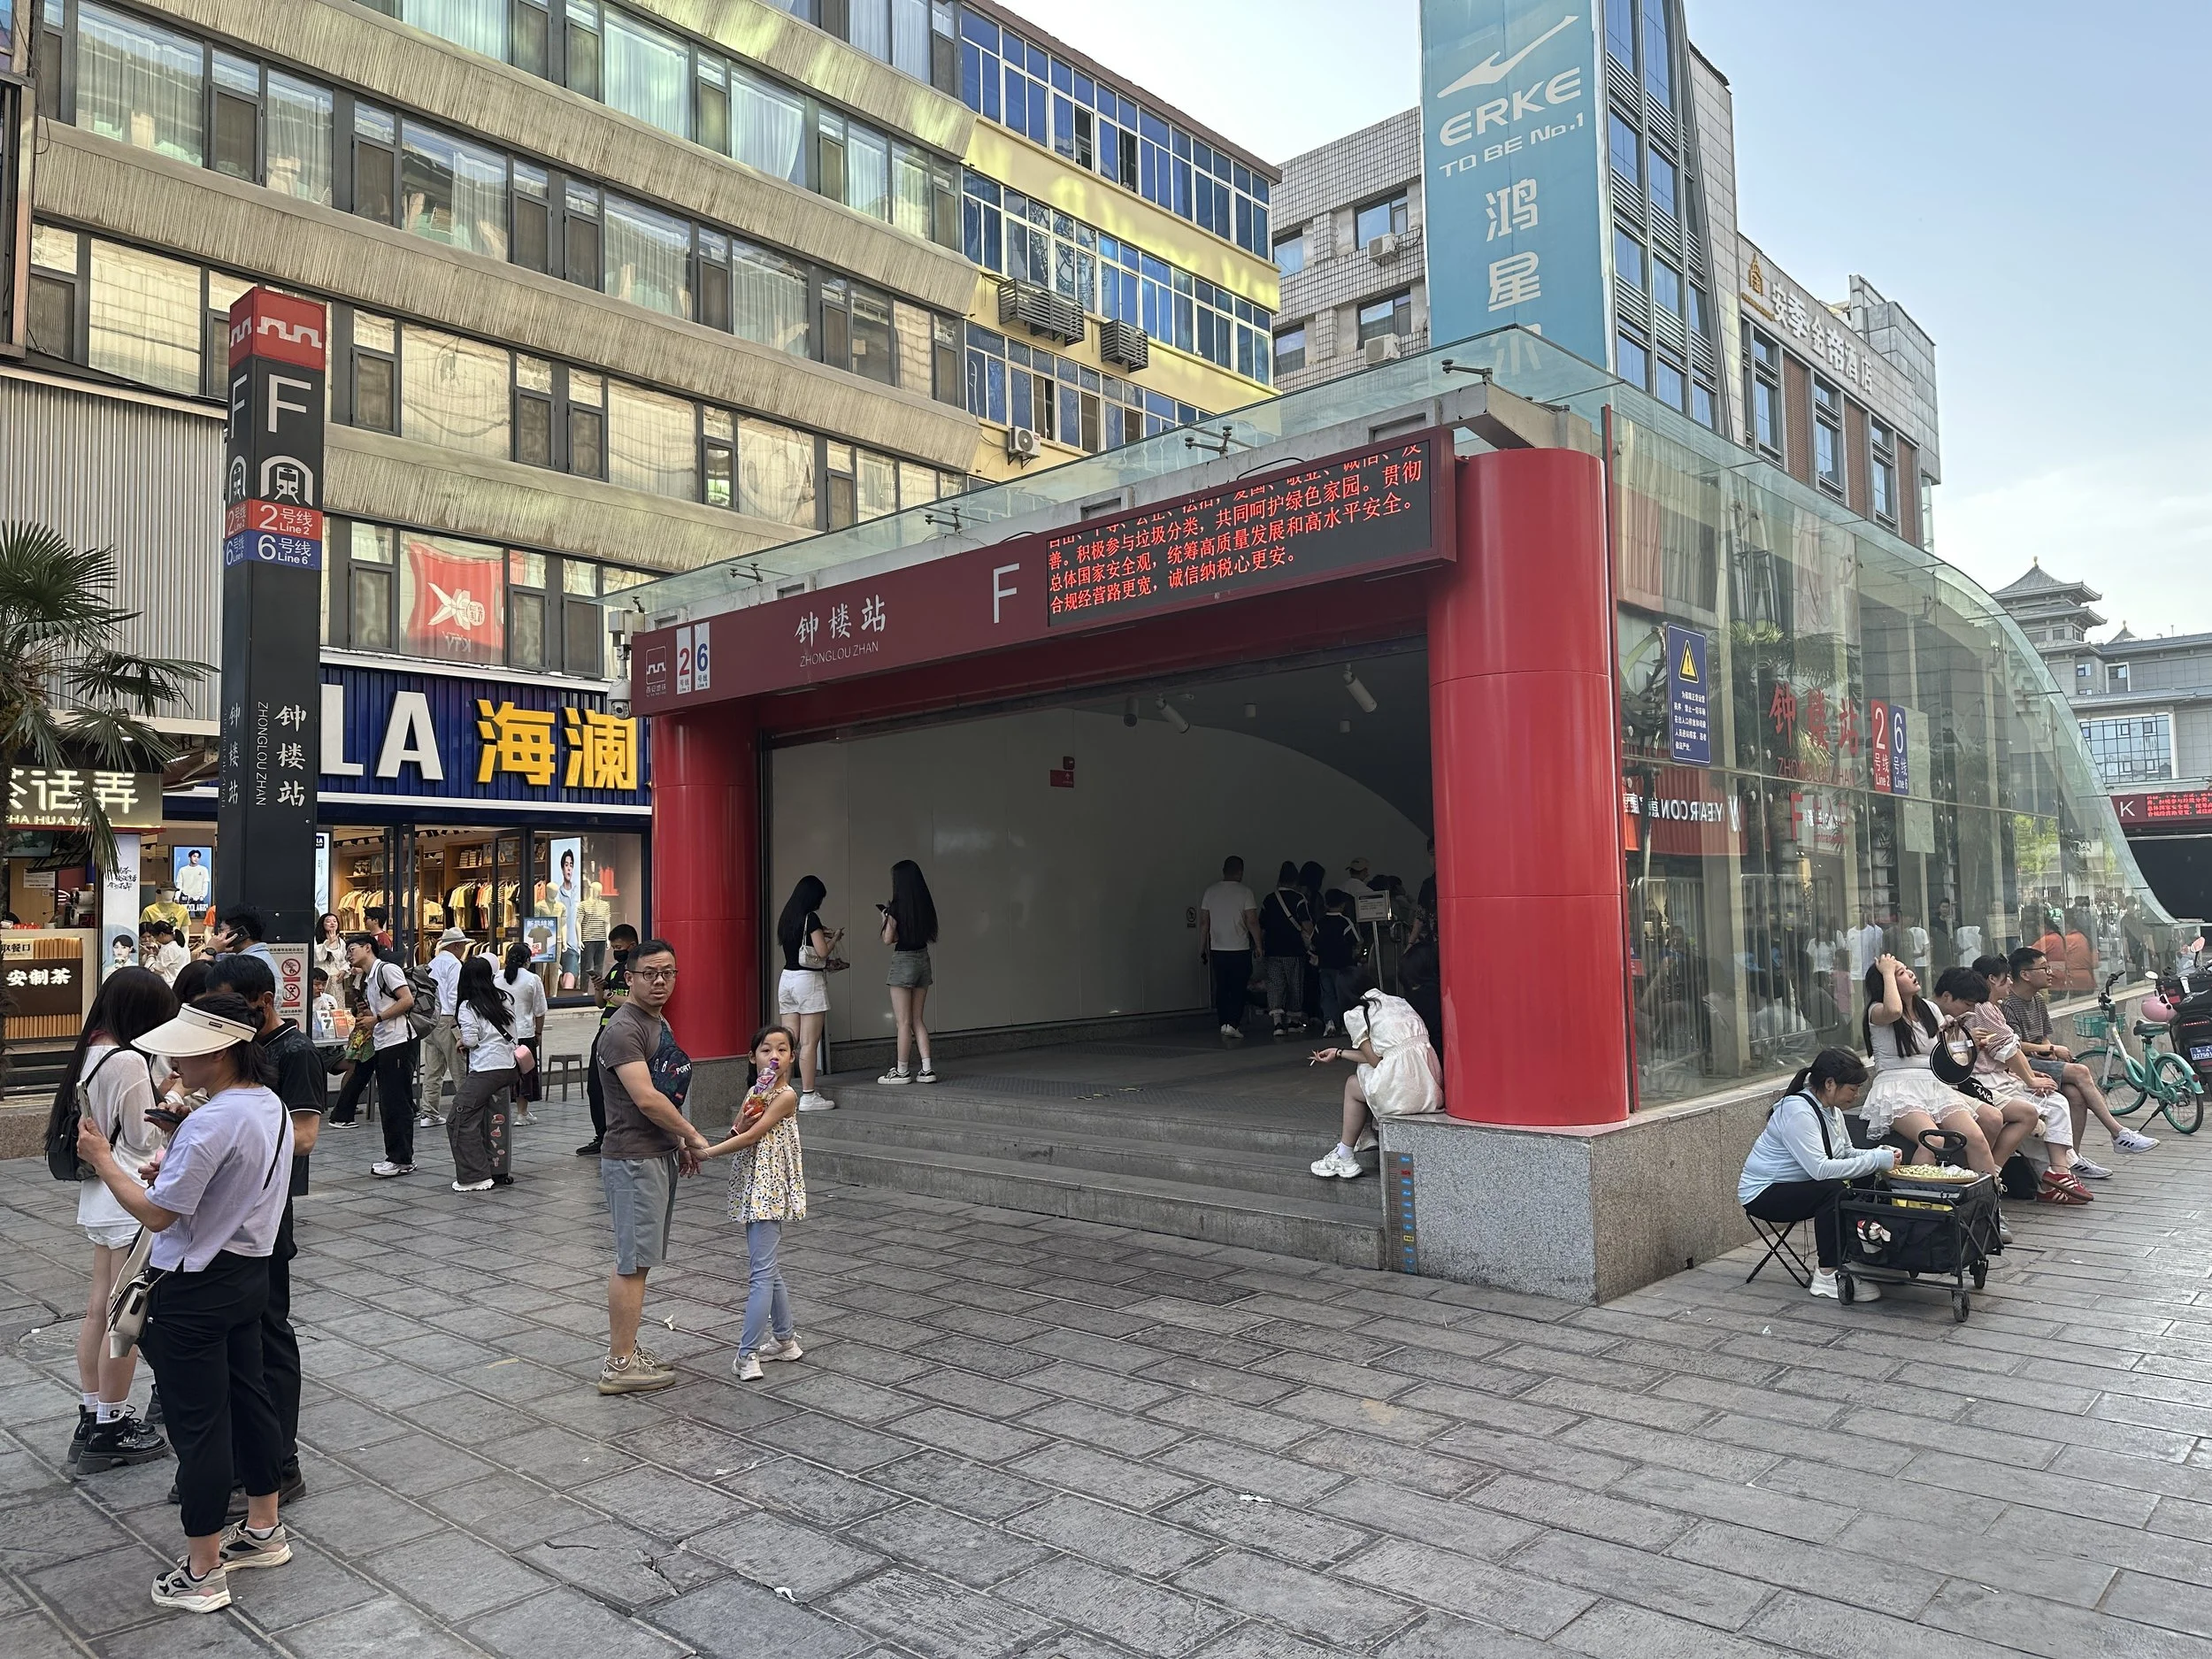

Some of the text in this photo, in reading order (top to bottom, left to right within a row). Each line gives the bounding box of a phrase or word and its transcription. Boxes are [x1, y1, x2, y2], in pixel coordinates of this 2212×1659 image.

[1440, 66, 1582, 147] ERKE
[1439, 111, 1584, 177] TO BE No.1
[230, 373, 248, 440] F
[267, 373, 311, 434] F
[280, 522, 310, 535] Line 2
[1049, 492, 1411, 592] 总体国家安全观，统筹高质量发展和高水平安全。
[278, 552, 300, 563] Line
[1050, 545, 1294, 614] 合规经营路更宽，诚信纳税心更安。
[795, 594, 887, 648] 钟楼站
[992, 563, 1021, 624] F
[679, 647, 690, 676] 2
[697, 642, 709, 672] 6
[799, 641, 879, 668] ZHONGLOU ZHAN
[320, 683, 444, 780] LA
[476, 698, 638, 790] 海澜
[1769, 681, 1858, 757] 钟楼站
[228, 702, 241, 805] 钟楼站
[256, 701, 269, 806] ZHONGLOU ZHAN
[273, 704, 307, 807] 钟楼站
[1876, 775, 1886, 786] Line
[1894, 777, 1904, 788] Line
[2119, 801, 2136, 818] K
[34, 814, 66, 826] HUA
[1789, 792, 1804, 841] F
[6, 967, 73, 987] 安制茶
